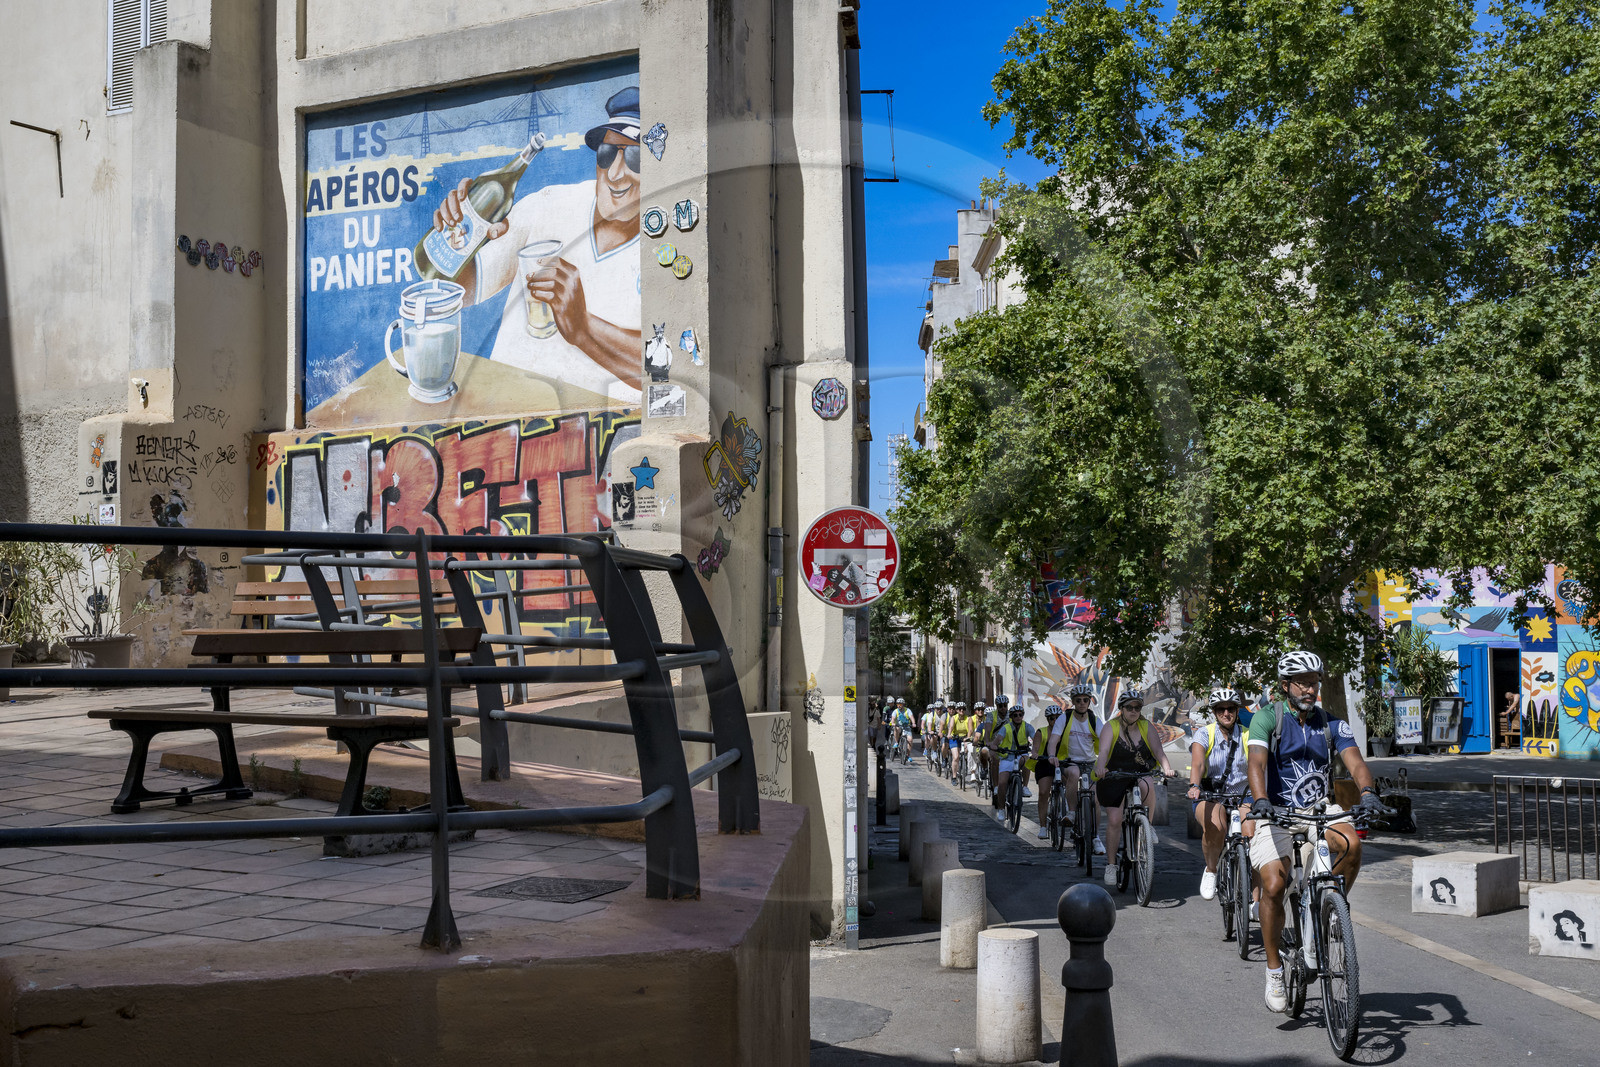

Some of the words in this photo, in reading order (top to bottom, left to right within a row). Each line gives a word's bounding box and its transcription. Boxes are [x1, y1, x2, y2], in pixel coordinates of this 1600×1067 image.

[335, 121, 387, 162] LES
[305, 164, 419, 213] APÉROS
[343, 214, 381, 249] DU
[310, 247, 413, 292] PANIER
[433, 248, 453, 270] PANIER
[1408, 706, 1420, 716] SPA
[1434, 715, 1447, 723] FISH
